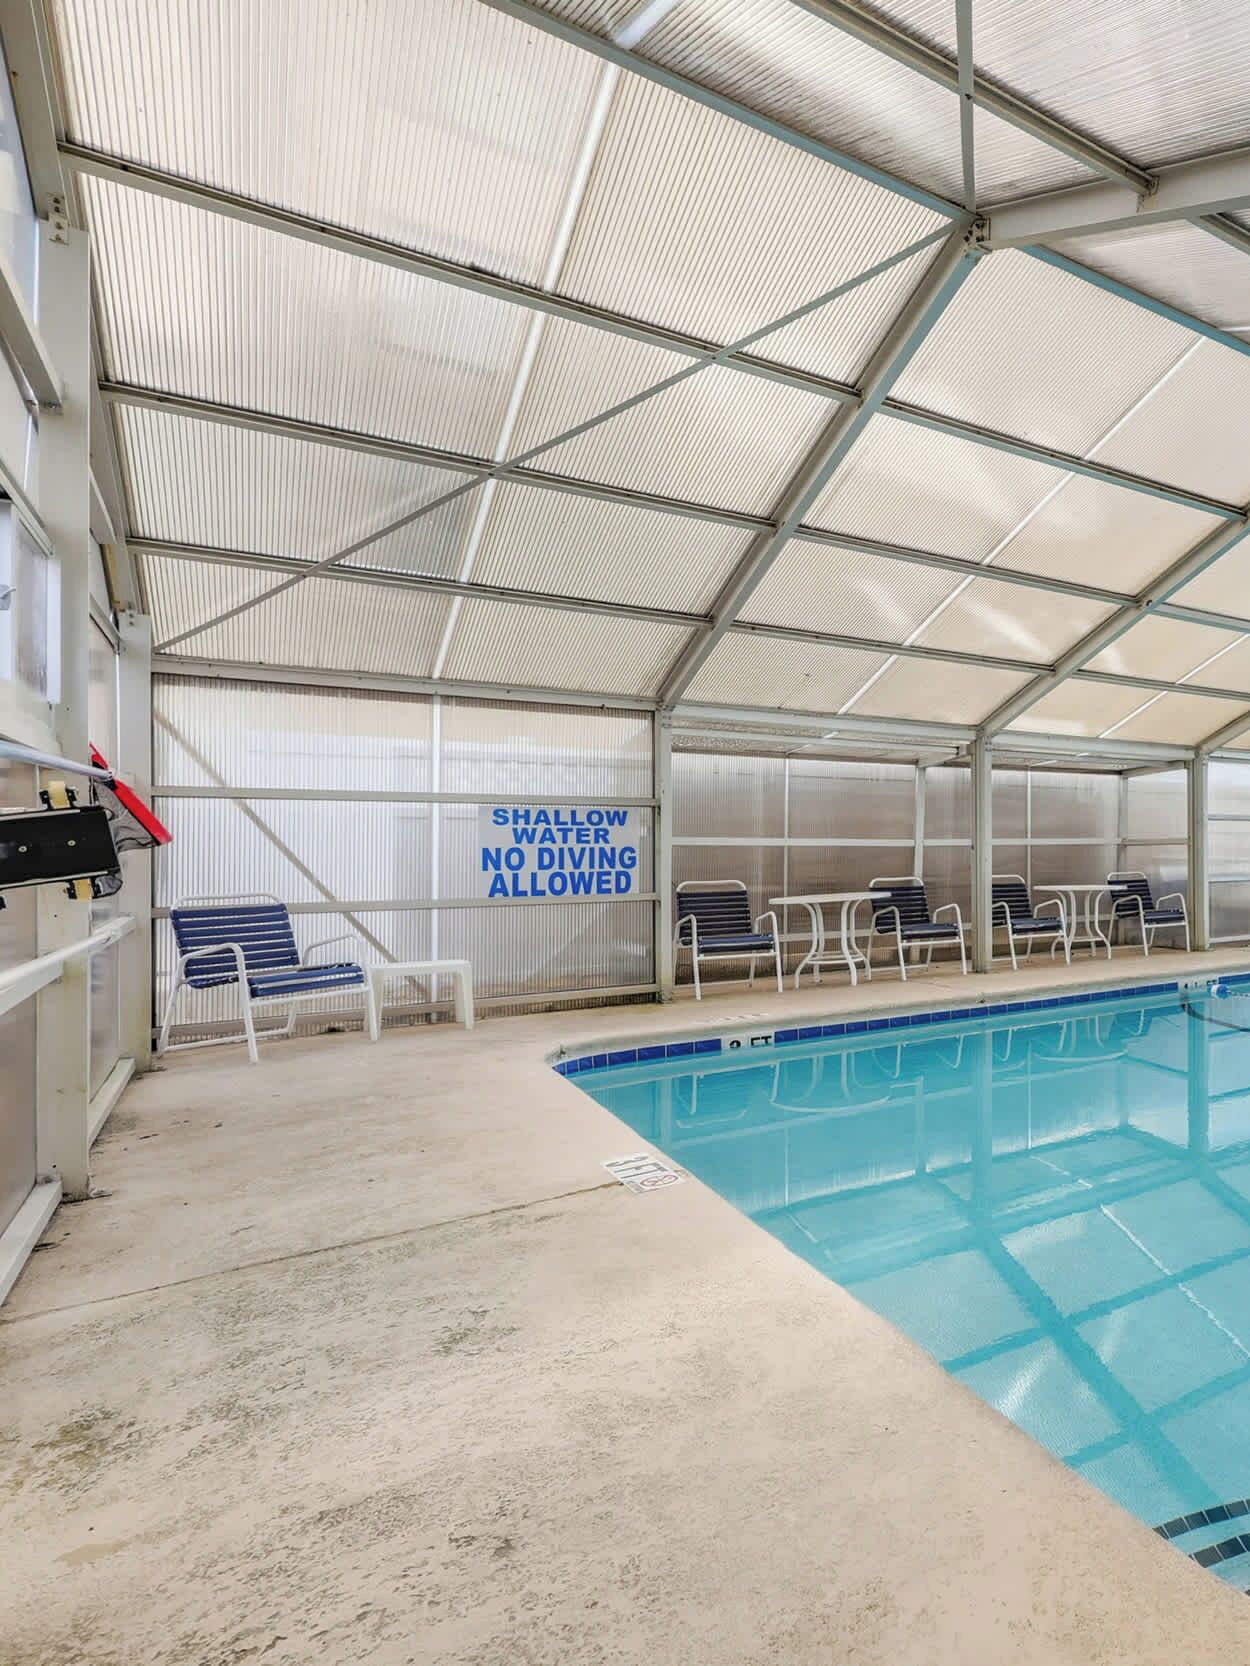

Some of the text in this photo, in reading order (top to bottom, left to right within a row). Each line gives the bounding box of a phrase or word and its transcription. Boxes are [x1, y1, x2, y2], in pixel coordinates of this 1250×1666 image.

[492, 808, 628, 827] SHALLOW
[512, 827, 610, 845] WATER
[482, 846, 637, 872] NO DIVING
[488, 870, 632, 898] ALLOWED
